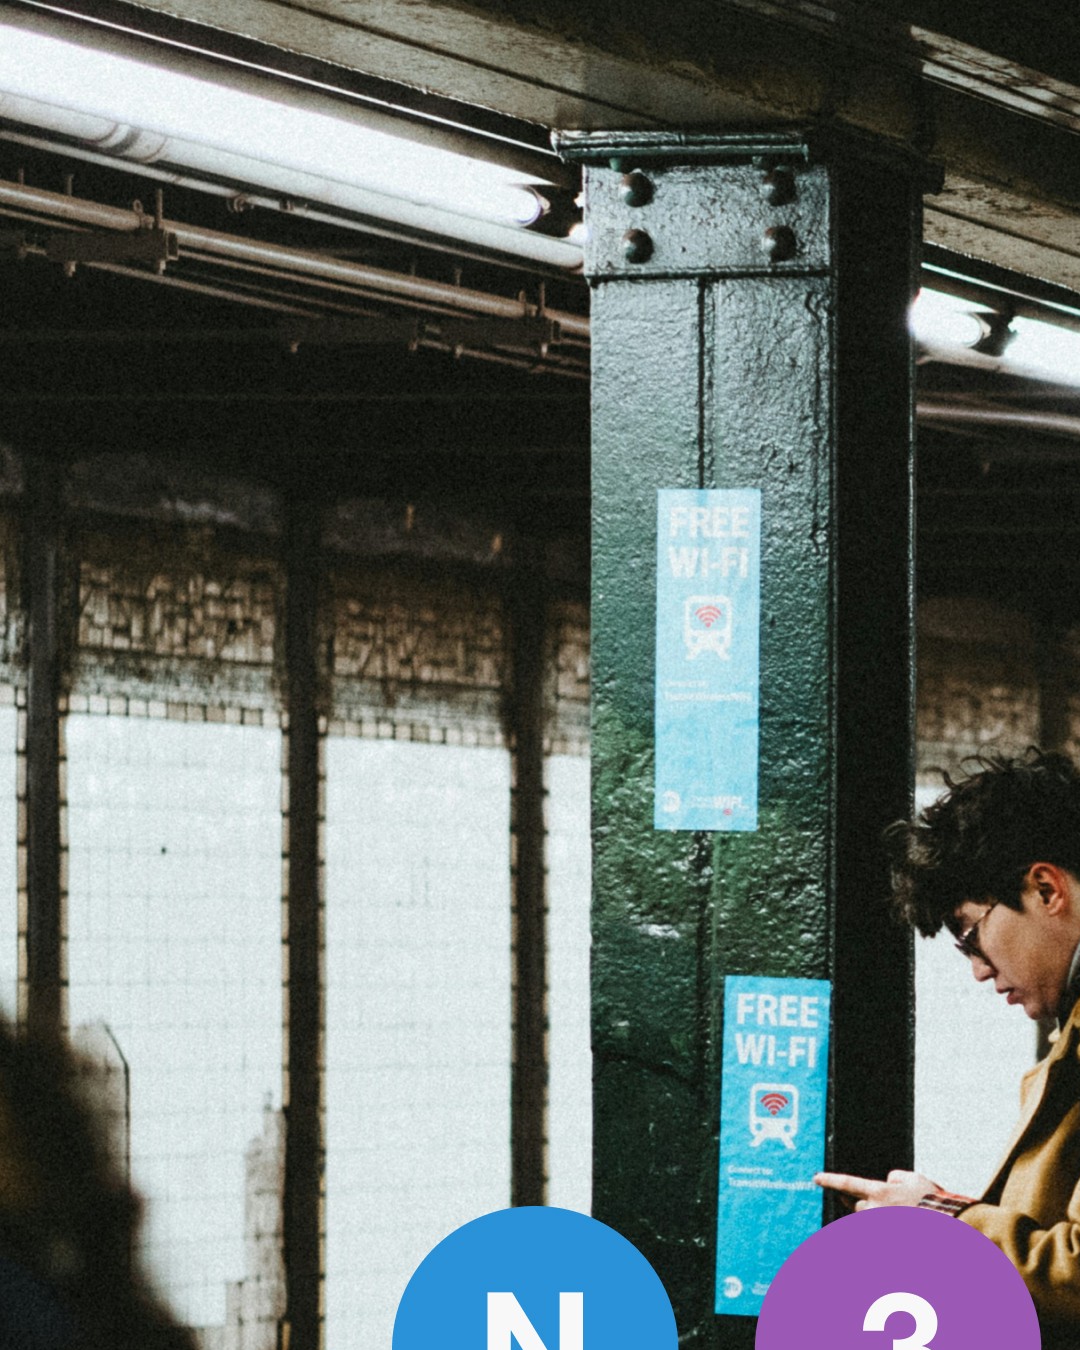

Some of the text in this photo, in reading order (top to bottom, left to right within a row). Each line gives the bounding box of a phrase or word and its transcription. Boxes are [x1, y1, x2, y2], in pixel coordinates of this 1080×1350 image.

[668, 505, 751, 539] FREE
[667, 545, 749, 580] WI-FI
[735, 993, 819, 1029] FREE
[734, 1032, 817, 1069] WI-FI
